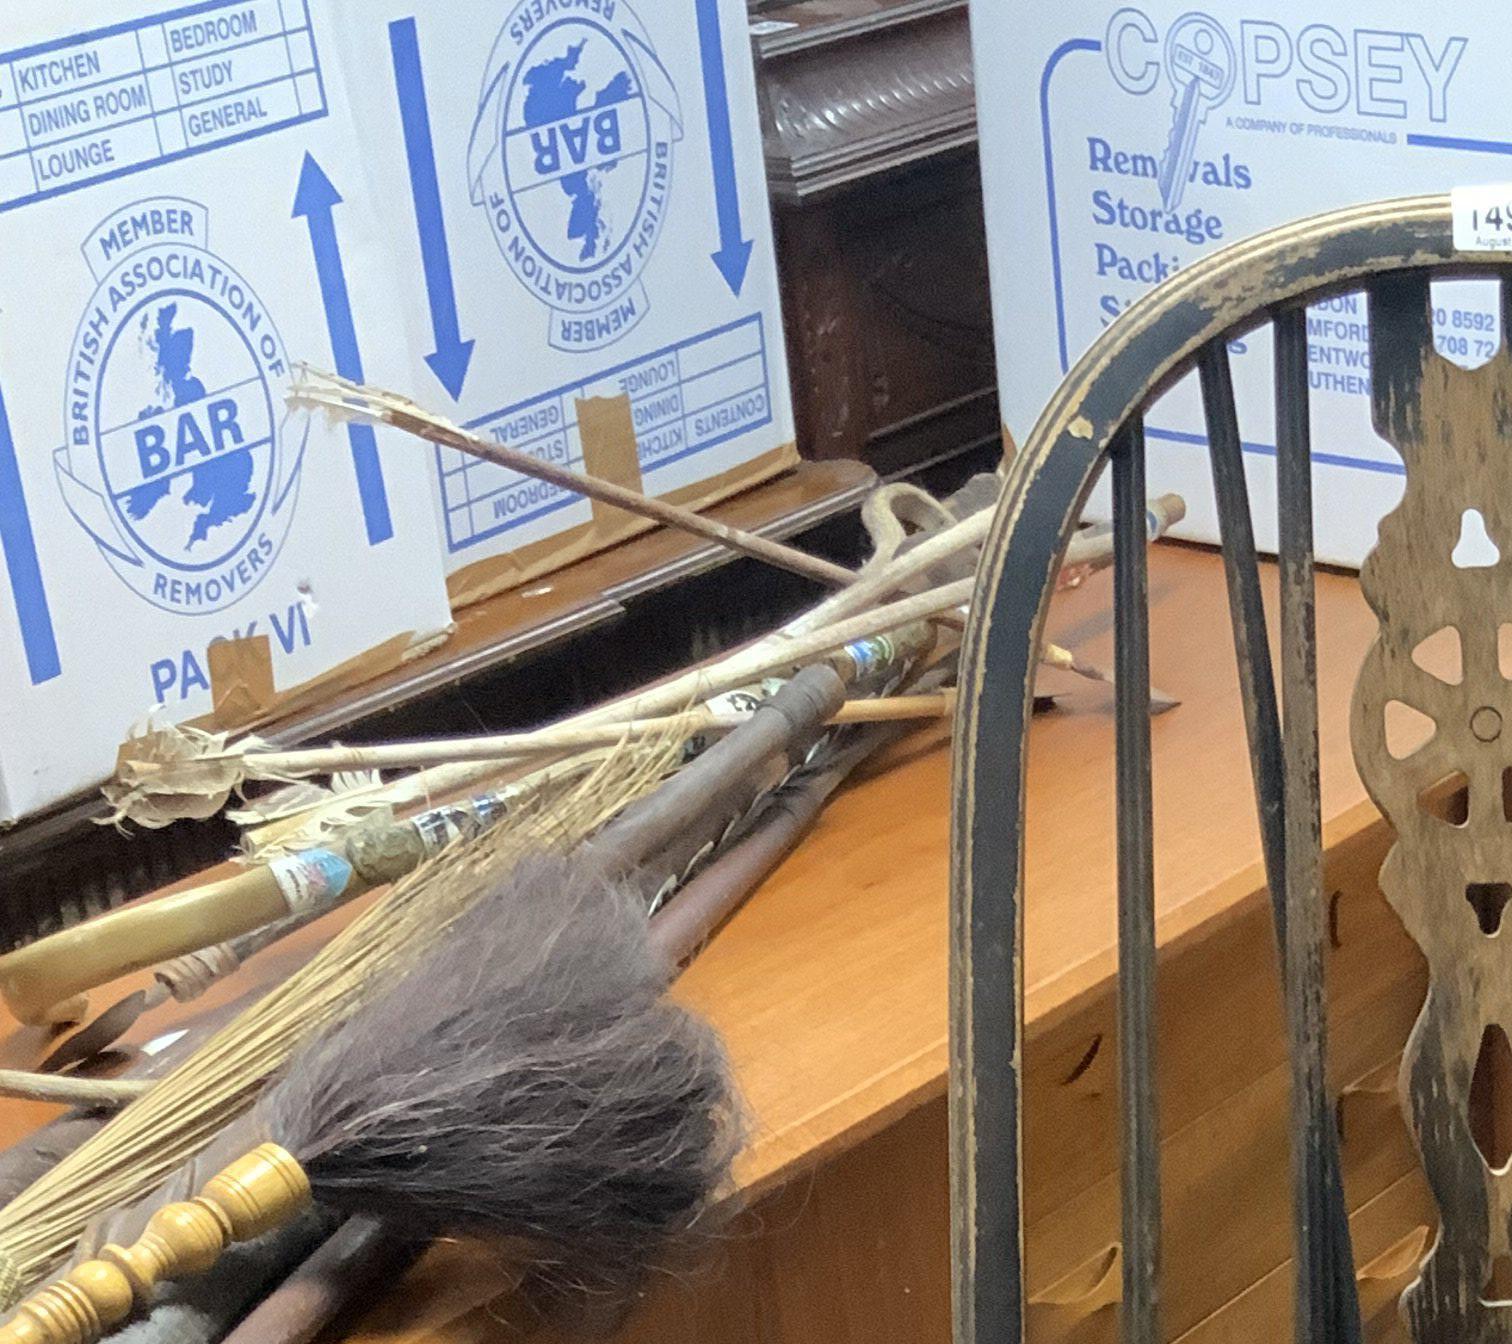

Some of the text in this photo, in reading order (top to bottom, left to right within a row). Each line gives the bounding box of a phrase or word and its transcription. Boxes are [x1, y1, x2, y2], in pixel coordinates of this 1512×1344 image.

[170, 10, 258, 52] BEDROOM
[18, 50, 101, 93] KITCHEN
[179, 60, 233, 95] STUDY
[1105, 7, 1469, 122] COPSEY
[28, 84, 148, 138] DINING ROOM
[188, 96, 268, 138] GENERAL
[1235, 117, 1286, 134] COMPANY
[1289, 121, 1305, 135] OF
[38, 138, 115, 182] LOUNGE
[530, 108, 622, 175] BAR
[1086, 136, 1253, 190] Remals
[100, 209, 194, 261] MEMBER
[489, 141, 668, 304] BRITISH ASSOCIATION OF
[1092, 189, 1224, 245] Storage
[1475, 236, 1512, 250] August
[561, 298, 637, 343] MEMBER
[1451, 310, 1495, 332] 8592
[73, 254, 286, 446] BRITISH ASSOCIATION OF
[1436, 335, 1468, 356] 708
[618, 359, 676, 393] LOUNGE
[1309, 370, 1370, 396] UTHEN
[489, 404, 560, 443] GENERAL
[634, 394, 680, 427] DINING
[694, 394, 766, 437] CONTENTS
[134, 398, 245, 479] BAR
[639, 428, 683, 461] KITCH
[493, 482, 558, 520] EDROOM
[154, 532, 274, 606] REMOVERS
